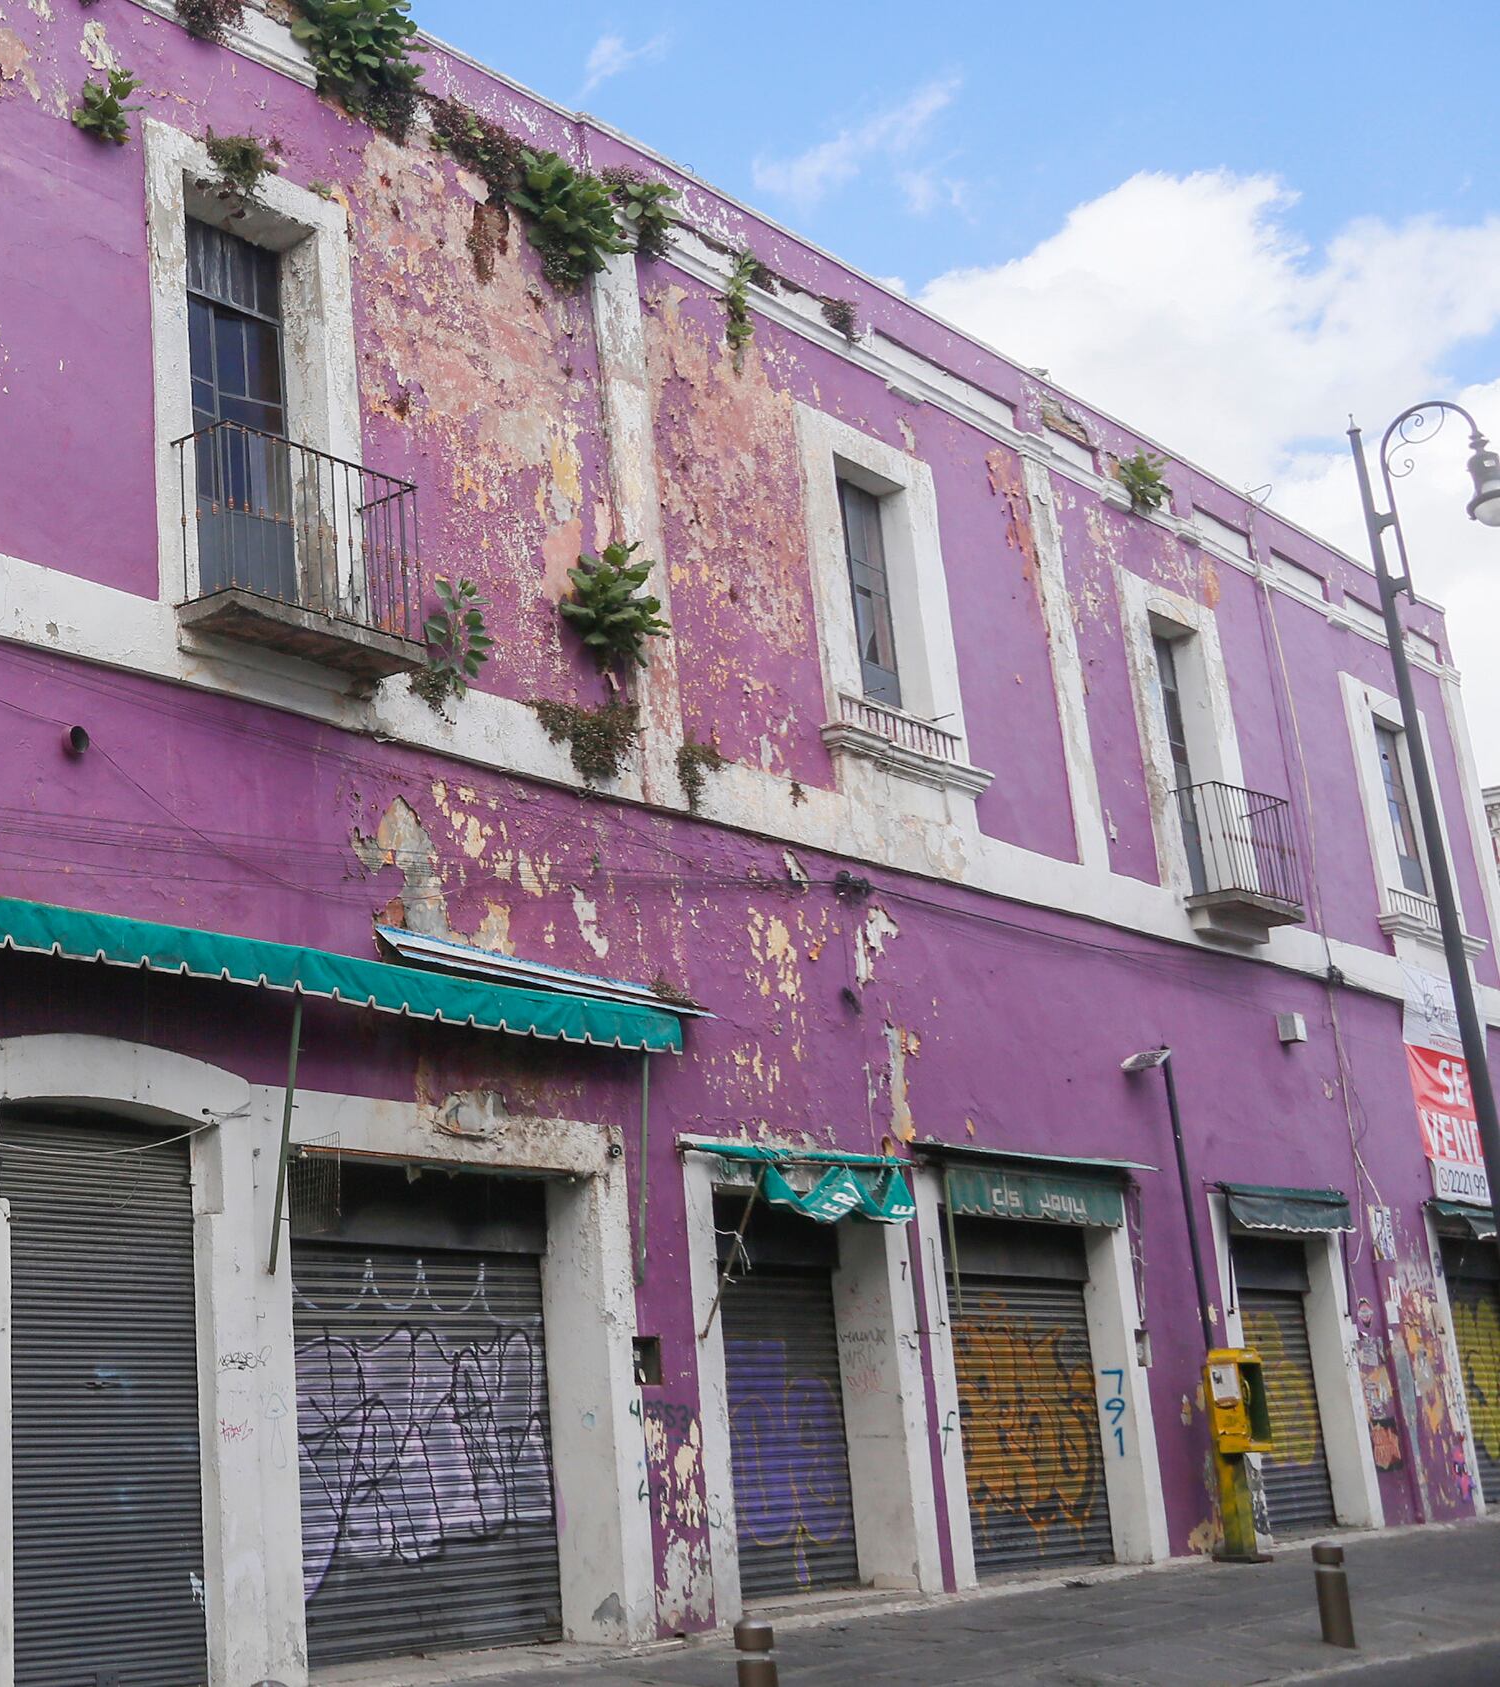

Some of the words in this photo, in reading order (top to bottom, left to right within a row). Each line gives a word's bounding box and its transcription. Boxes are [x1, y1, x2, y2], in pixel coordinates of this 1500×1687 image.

[1438, 1058, 1470, 1107] SE
[1421, 1108, 1483, 1165] VEND
[1448, 1170, 1473, 1196] 2221
[900, 1261, 908, 1281] 7
